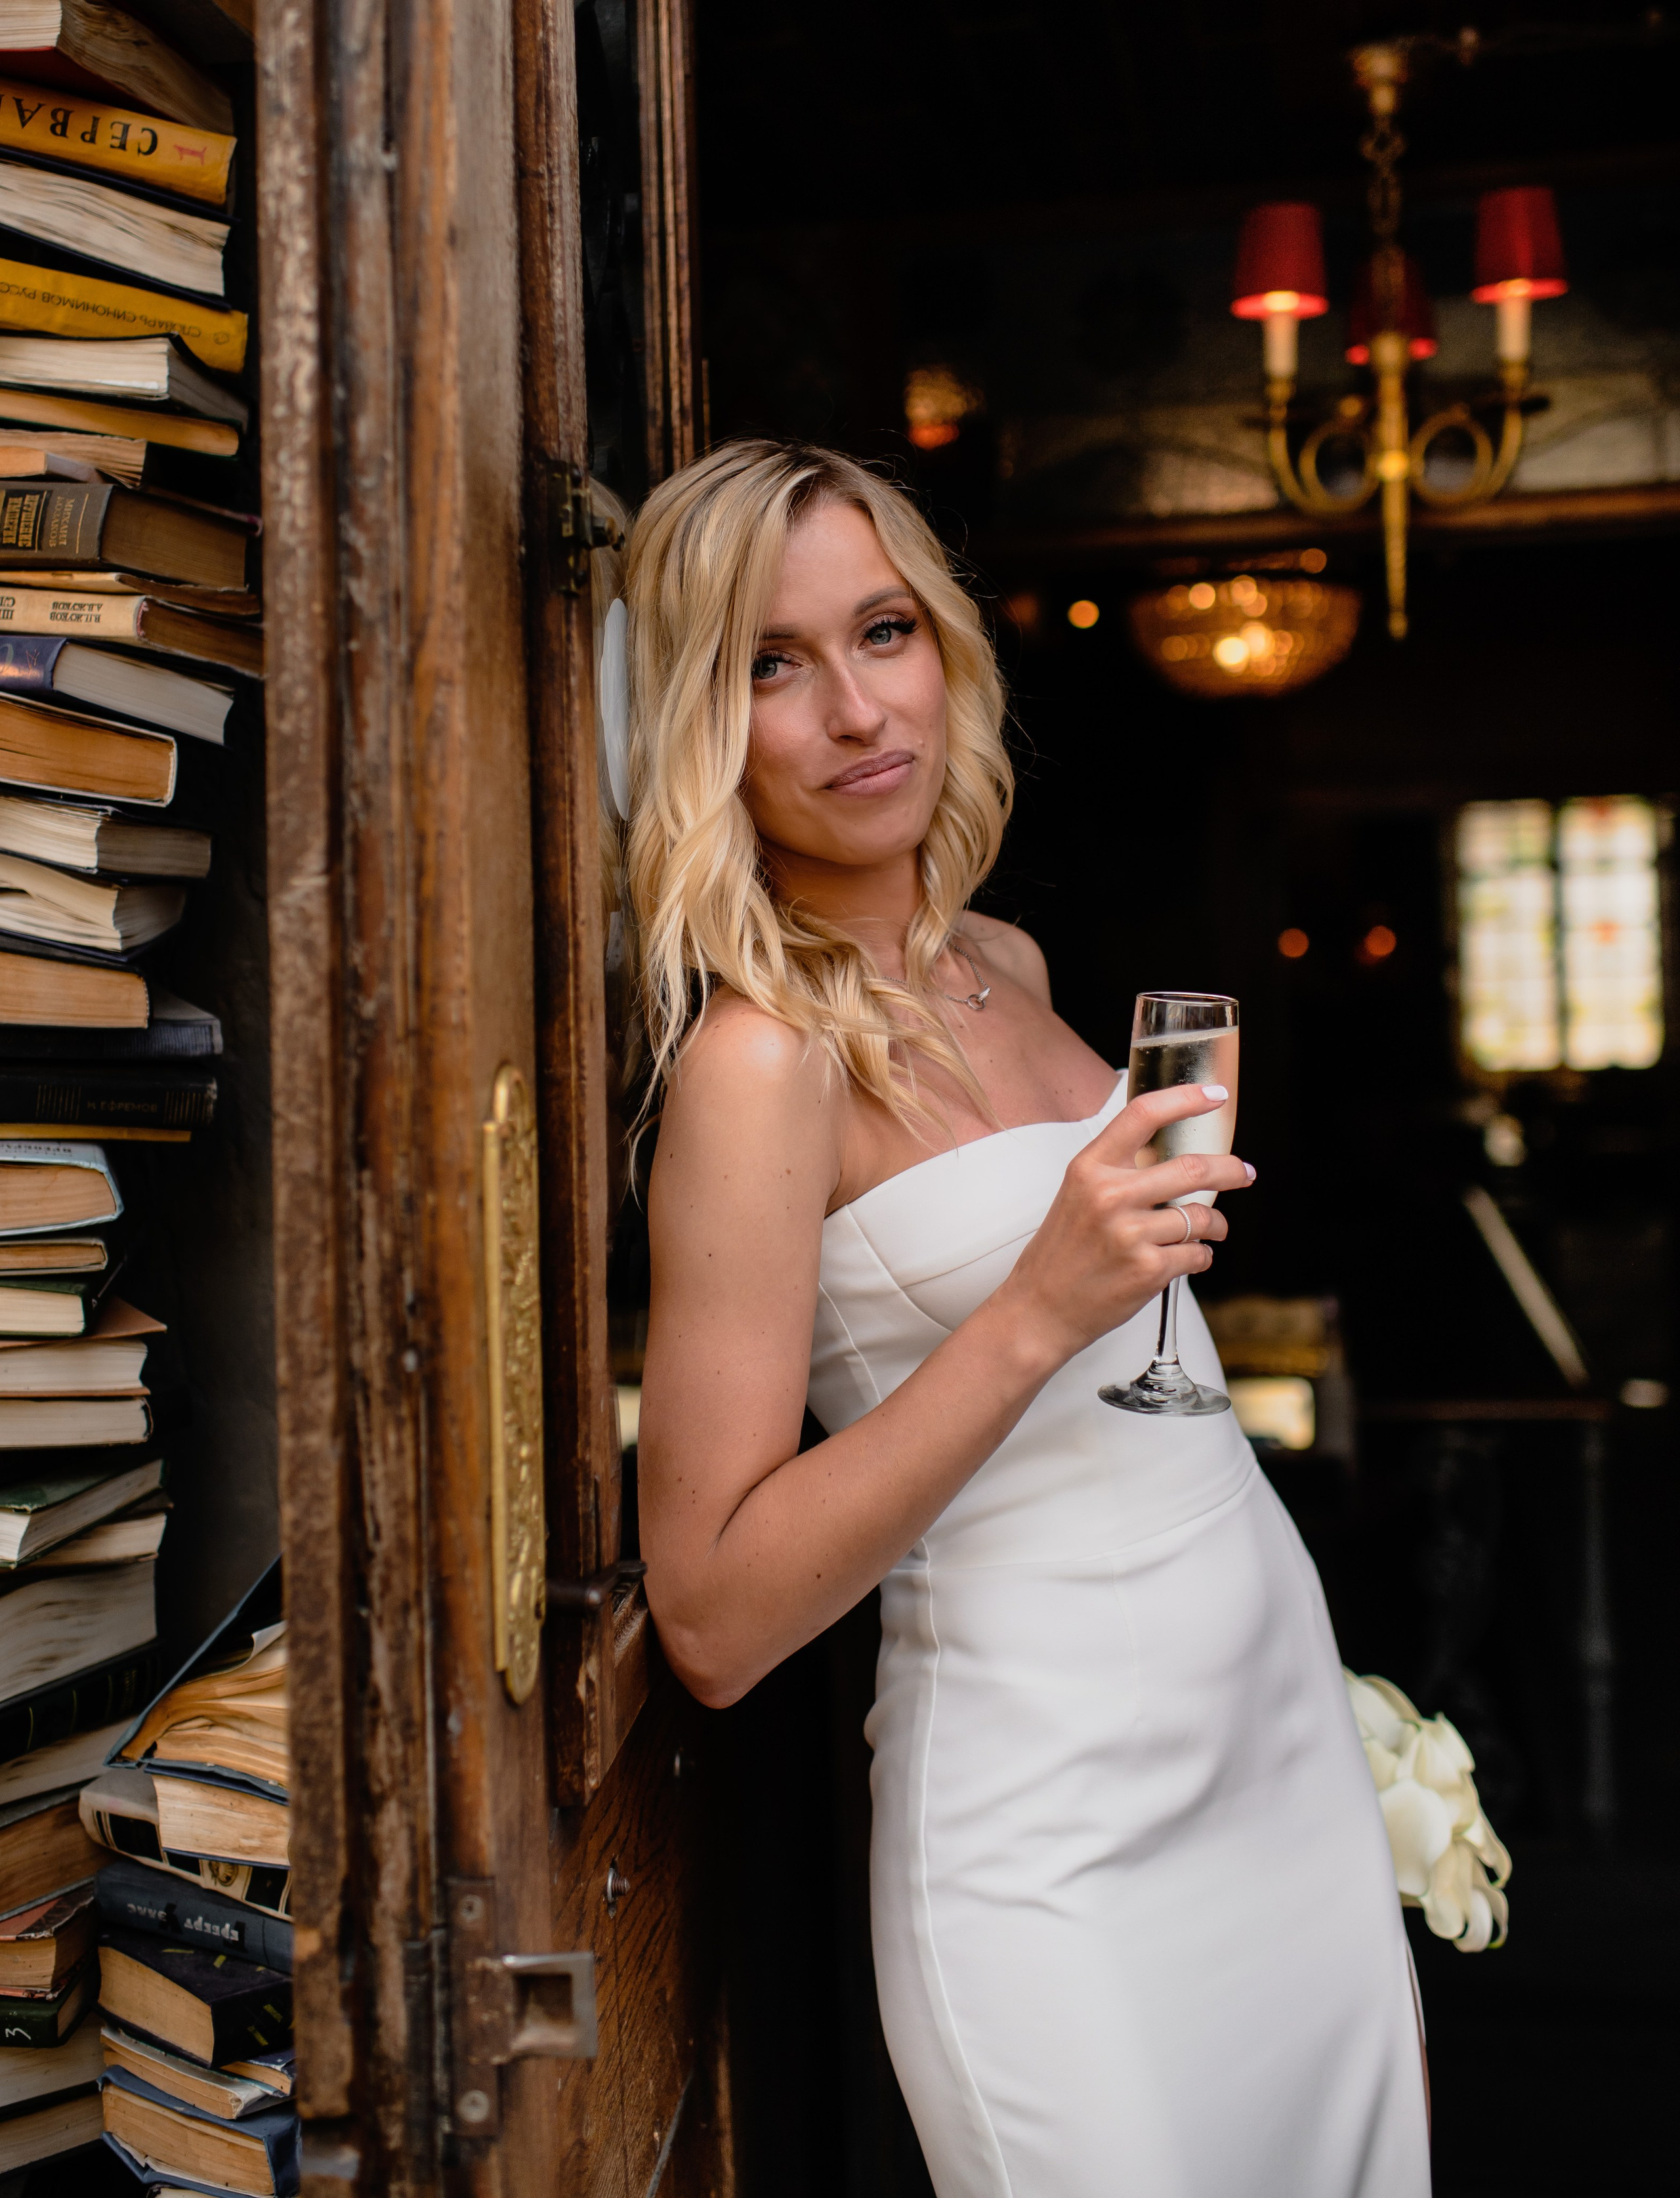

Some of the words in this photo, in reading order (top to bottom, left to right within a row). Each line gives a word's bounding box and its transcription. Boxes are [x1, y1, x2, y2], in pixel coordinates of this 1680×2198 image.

[0, 95, 158, 156] СЕРВА
[40, 293, 136, 324] СИНОНИМОВ
[138, 314, 201, 338] СЛОВАРЬ
[49, 496, 65, 548] КОЗАКОВ
[58, 497, 75, 546] МИХАИЛ
[100, 1099, 158, 1114] ЕФРЕМОВ
